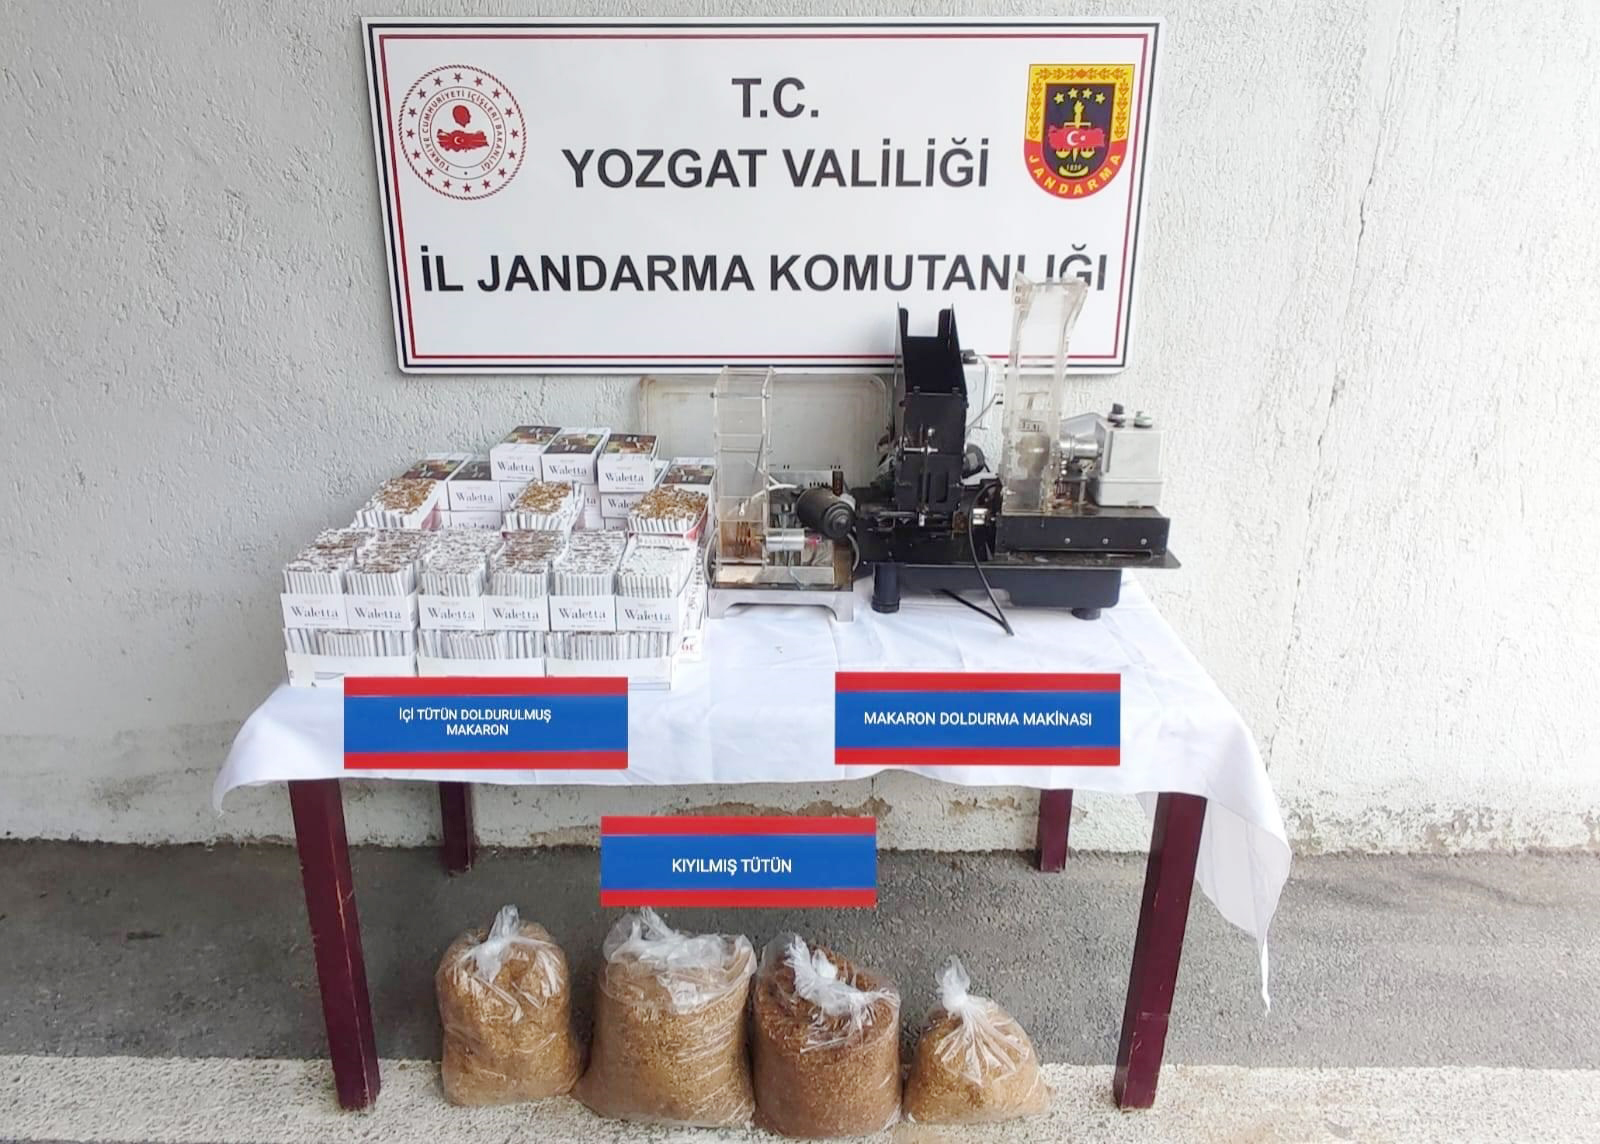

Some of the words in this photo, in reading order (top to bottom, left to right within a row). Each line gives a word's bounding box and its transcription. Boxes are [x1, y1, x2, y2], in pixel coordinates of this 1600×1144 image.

[731, 78, 819, 118] T.C.
[423, 89, 465, 134] CUMHURİYETİ
[467, 91, 500, 122] İÇİŞLERİ
[562, 149, 767, 188] YOZGAT
[783, 137, 989, 188] VALİLİĞİ
[1029, 154, 1122, 195] JANDARMA
[421, 246, 464, 292] İL
[478, 255, 755, 292] JANDARMA
[497, 461, 535, 473] Waletta
[549, 464, 587, 476] Waletta
[605, 471, 645, 483] Waletta
[456, 492, 494, 503] Waletta
[290, 606, 339, 618] Waletta
[354, 607, 402, 619] Waletta
[427, 607, 475, 619] Waletta
[492, 607, 539, 620] Waletta
[558, 607, 606, 620] Waletta
[624, 608, 671, 621] Waletta
